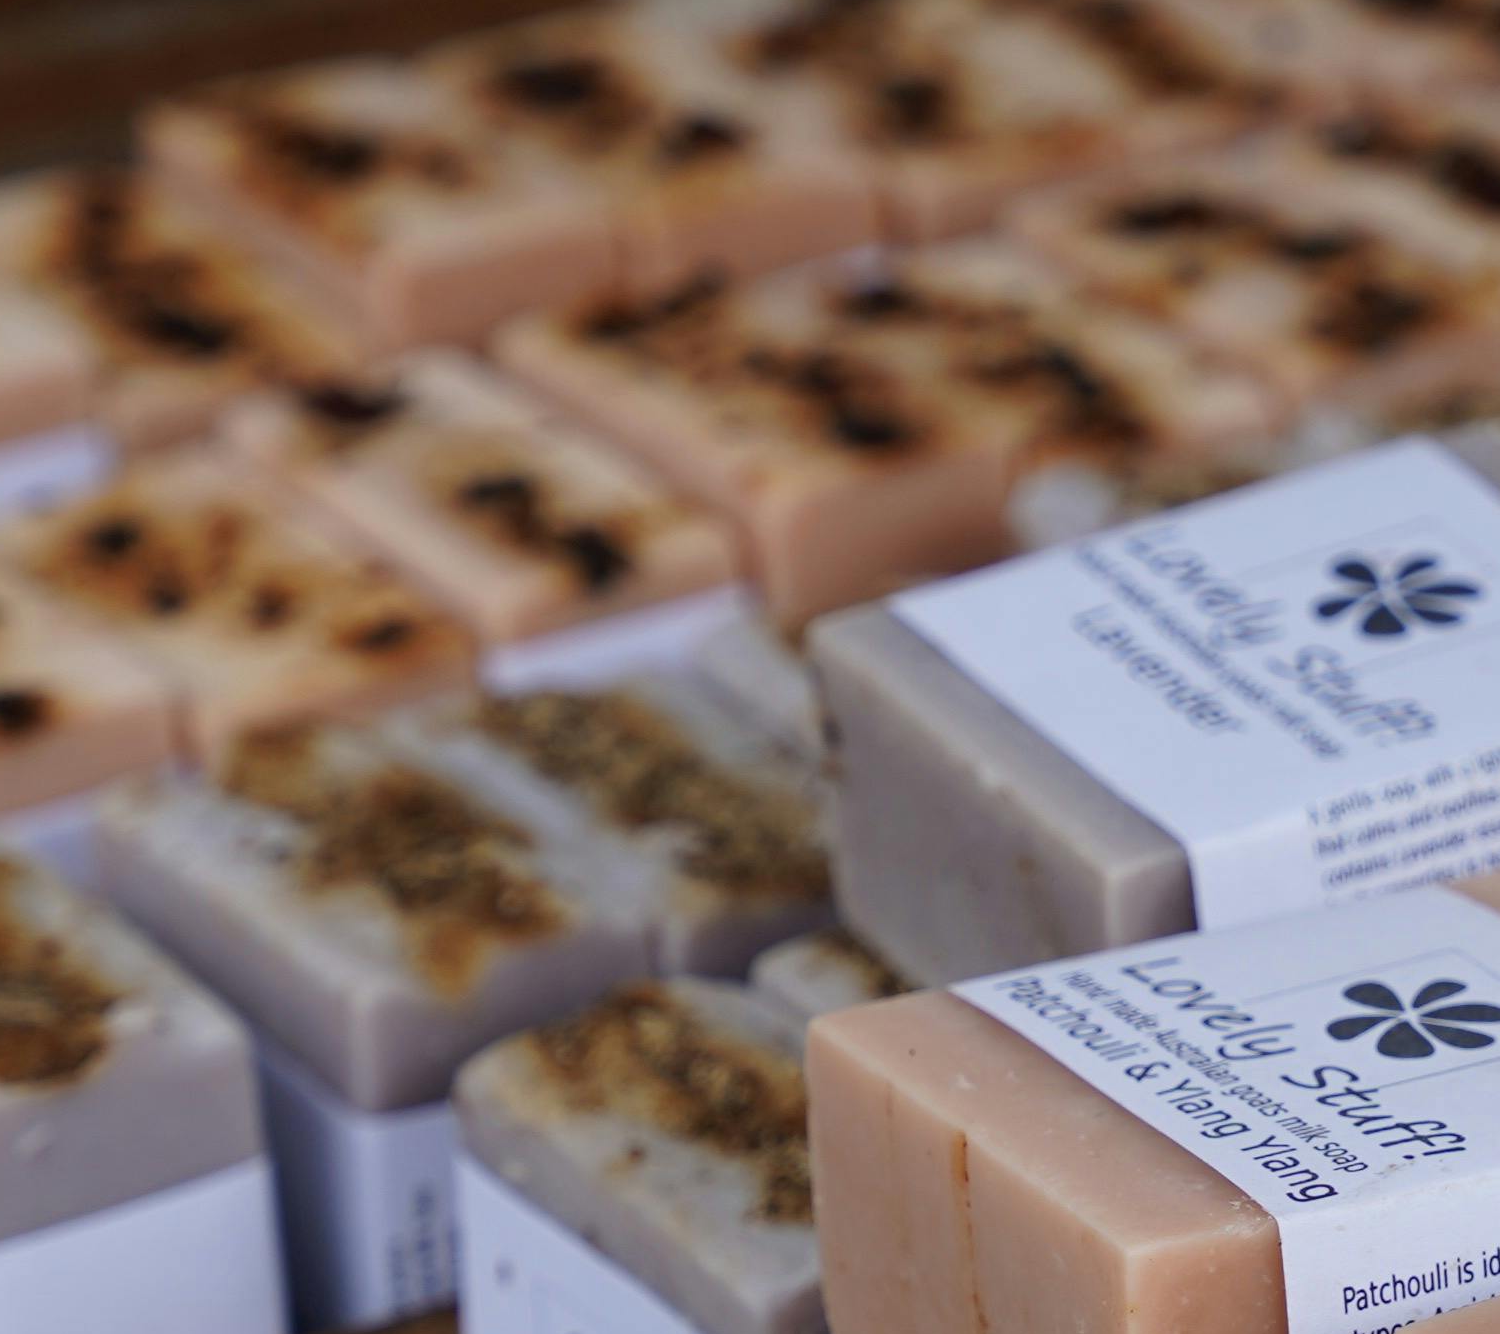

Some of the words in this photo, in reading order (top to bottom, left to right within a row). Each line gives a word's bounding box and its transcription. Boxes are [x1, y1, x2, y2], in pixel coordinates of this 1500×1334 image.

[993, 975, 1149, 1062] Patchouli
[1123, 1061, 1171, 1082] &
[1155, 1077, 1252, 1140] Ylang
[1240, 1133, 1340, 1203] Ylang
[1102, 998, 1159, 1032] made
[1154, 1028, 1240, 1086] Australian
[1220, 1083, 1288, 1118] goats
[1275, 1115, 1331, 1144] milk
[1313, 1140, 1369, 1174] soap
[1120, 956, 1296, 1061] Lovely
[1279, 1064, 1467, 1161] Stuff!
[1342, 1260, 1449, 1316] Patchouli
[1456, 1257, 1476, 1286] is
